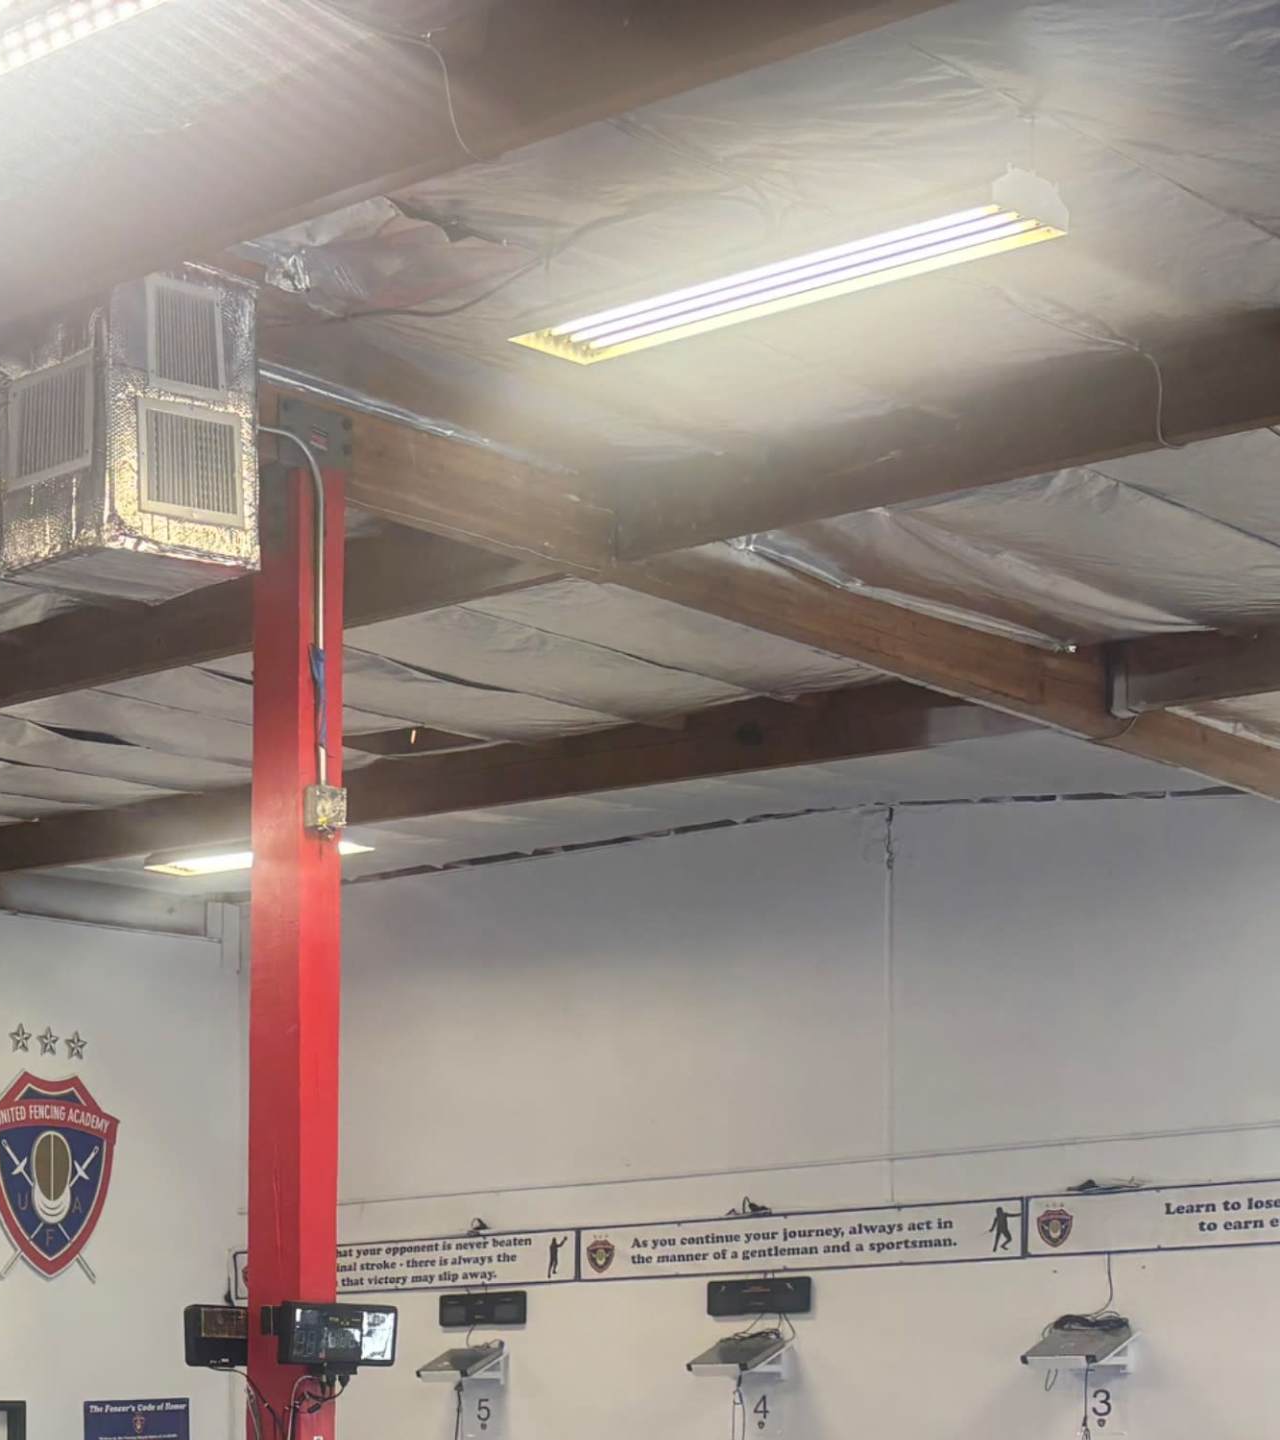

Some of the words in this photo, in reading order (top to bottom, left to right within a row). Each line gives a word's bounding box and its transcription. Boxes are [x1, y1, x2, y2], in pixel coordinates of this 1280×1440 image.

[29, 1105, 66, 1121] FENCING
[67, 1109, 110, 1132] ACADEMY
[18, 1192, 28, 1210] U
[72, 1198, 82, 1213] A
[1165, 1202, 1216, 1215] Learn
[1223, 1200, 1241, 1211] to
[631, 1237, 648, 1249] As
[651, 1238, 676, 1250] you
[680, 1232, 740, 1246] continue
[744, 1231, 779, 1243] your
[783, 1226, 845, 1242] journey,
[848, 1222, 903, 1236] always
[907, 1219, 933, 1231] act
[937, 1218, 953, 1230] in
[1199, 1220, 1217, 1232] to
[1224, 1220, 1264, 1230] earn
[46, 1229, 55, 1246] F
[356, 1247, 383, 1258] your
[385, 1243, 439, 1256] opponent
[442, 1240, 452, 1251] is
[456, 1239, 489, 1250] never
[492, 1236, 532, 1247] beaten
[631, 1252, 652, 1264] the
[656, 1252, 709, 1263] manner
[713, 1249, 727, 1260] of
[730, 1250, 738, 1259] a
[742, 1245, 818, 1261] gentleman
[823, 1241, 850, 1254] and
[855, 1243, 864, 1252] a
[869, 1237, 957, 1253] sportsman.
[360, 1260, 397, 1271] stroke
[406, 1258, 436, 1269] there
[439, 1256, 448, 1266] is
[451, 1253, 493, 1266] always
[497, 1252, 517, 1263] the
[341, 1277, 364, 1287] that
[368, 1275, 407, 1286] victory
[411, 1273, 435, 1284] may
[438, 1270, 459, 1283] slip
[462, 1270, 497, 1281] away.
[137, 1403, 156, 1412] Code
[476, 1398, 491, 1422] 5
[752, 1395, 770, 1419] 4
[1092, 1389, 1112, 1417] 3
